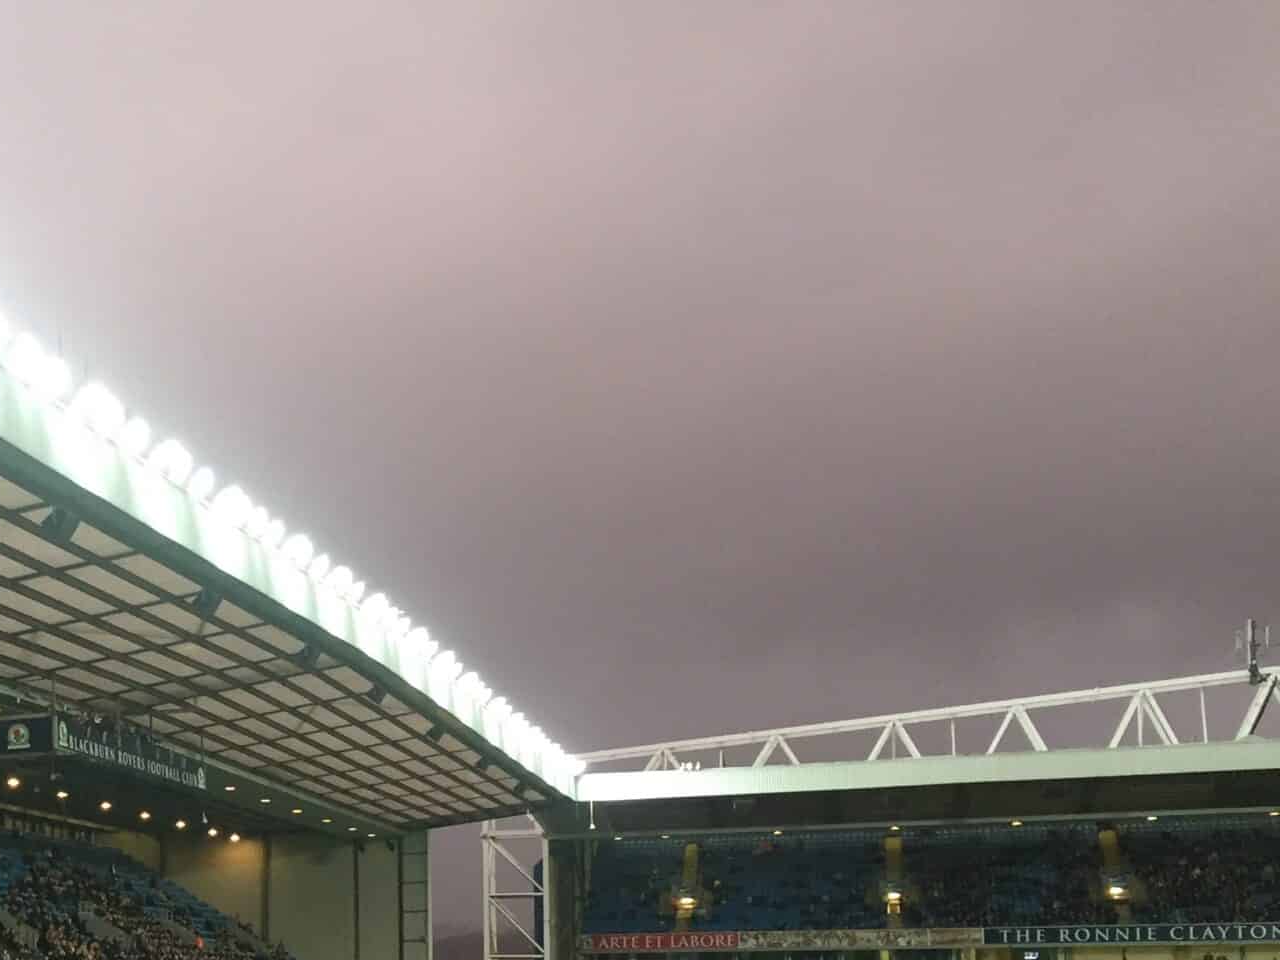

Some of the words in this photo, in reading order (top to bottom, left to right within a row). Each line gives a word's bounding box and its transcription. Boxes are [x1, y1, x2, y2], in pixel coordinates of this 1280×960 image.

[598, 935, 641, 950] ARTE
[645, 934, 665, 949] ET
[670, 933, 737, 949] LABORE
[999, 928, 1047, 943] THE
[1058, 926, 1158, 943] RONNIE
